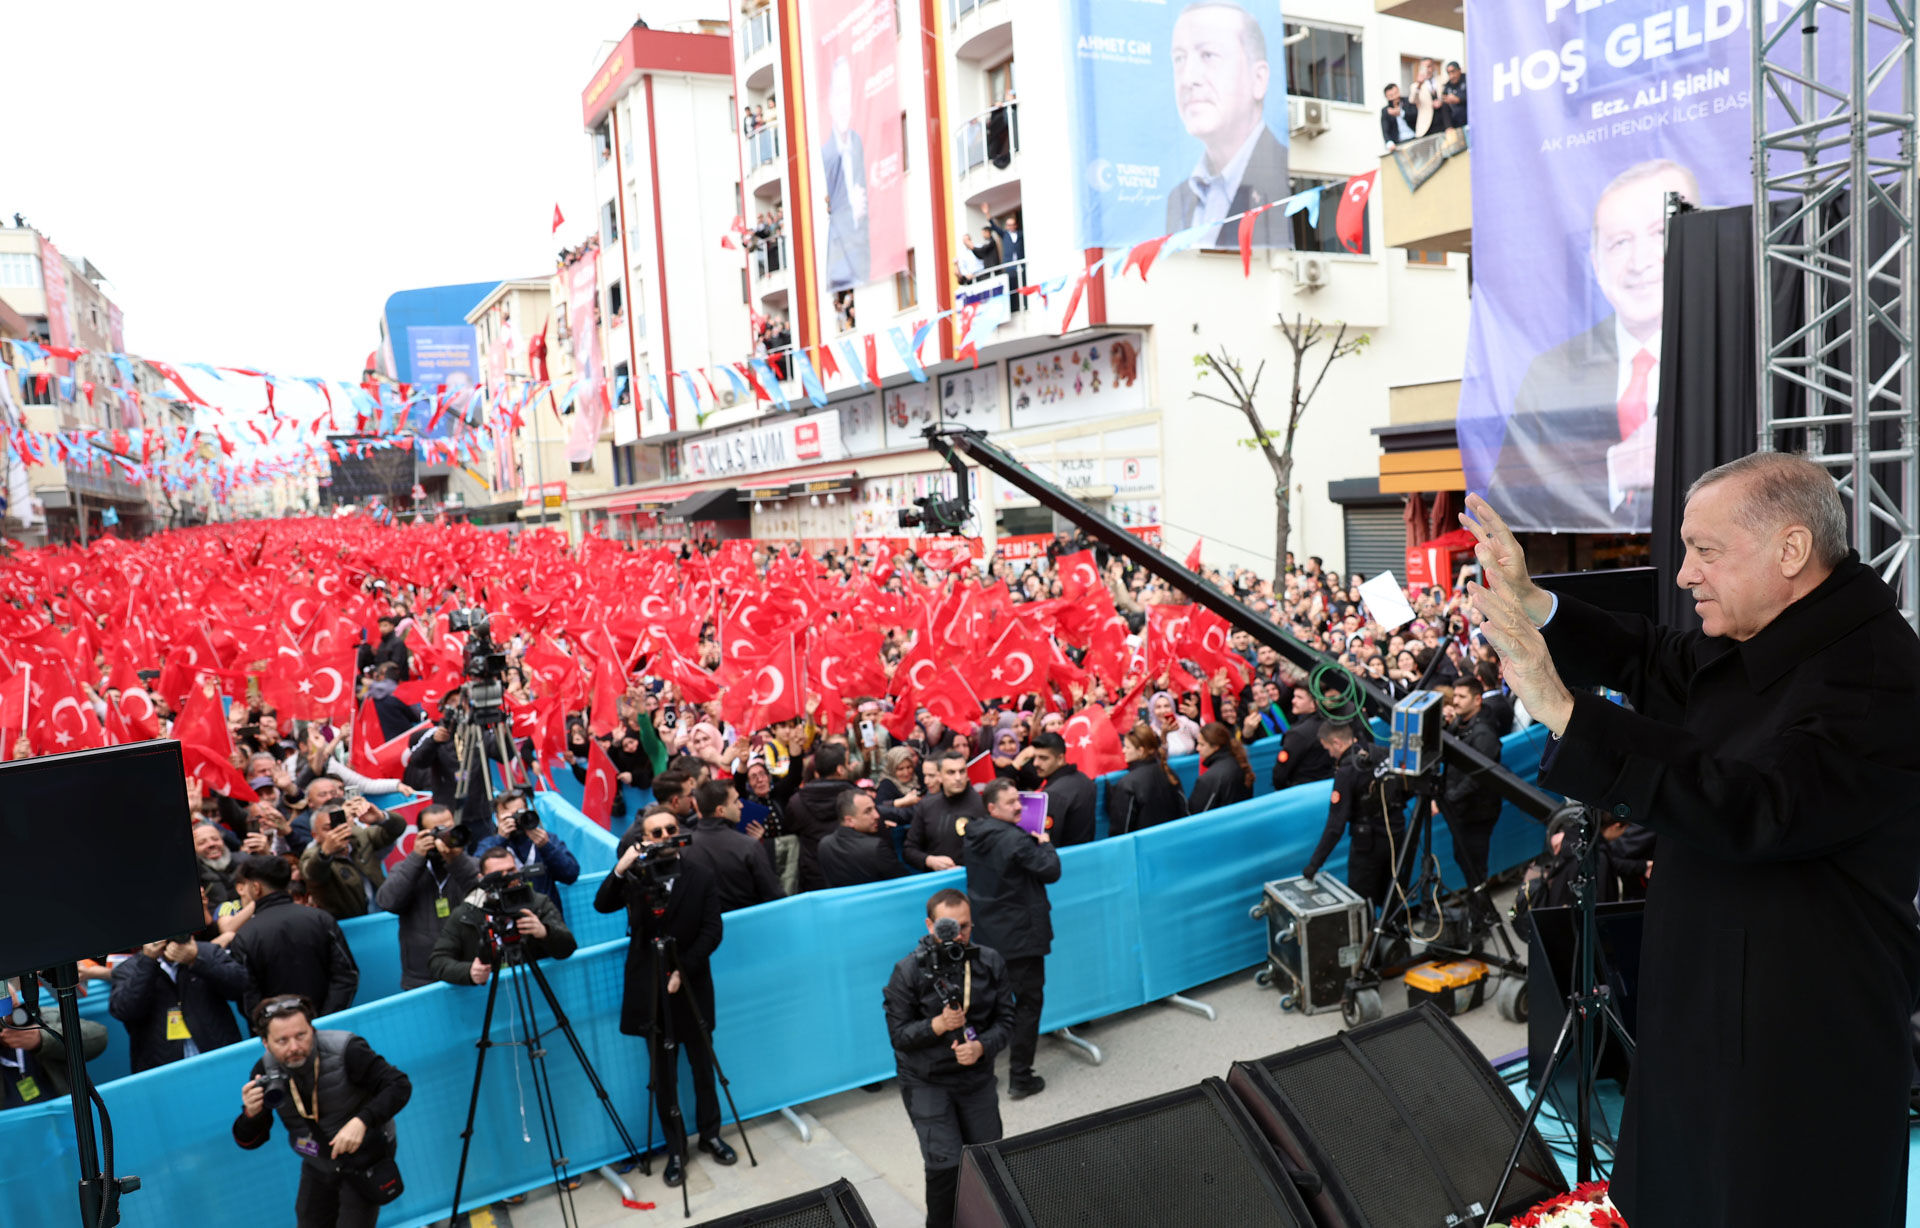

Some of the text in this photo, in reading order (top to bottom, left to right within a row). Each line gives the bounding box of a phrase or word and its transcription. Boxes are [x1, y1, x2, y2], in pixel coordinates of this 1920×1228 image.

[1077, 34, 1126, 53] AHMET
[1492, 38, 1587, 102] HOŞ
[1591, 67, 1730, 120] Ecz. ALİ ŞİRİN
[1540, 136, 1563, 152] AK
[1566, 124, 1608, 149] PARTİ
[1611, 111, 1669, 138] PENDİK
[1672, 99, 1709, 123] İLÇE
[706, 438, 746, 474] KLAS
[750, 431, 785, 467] AVM
[1061, 459, 1094, 470] KLAS
[1066, 475, 1092, 488] AVM
